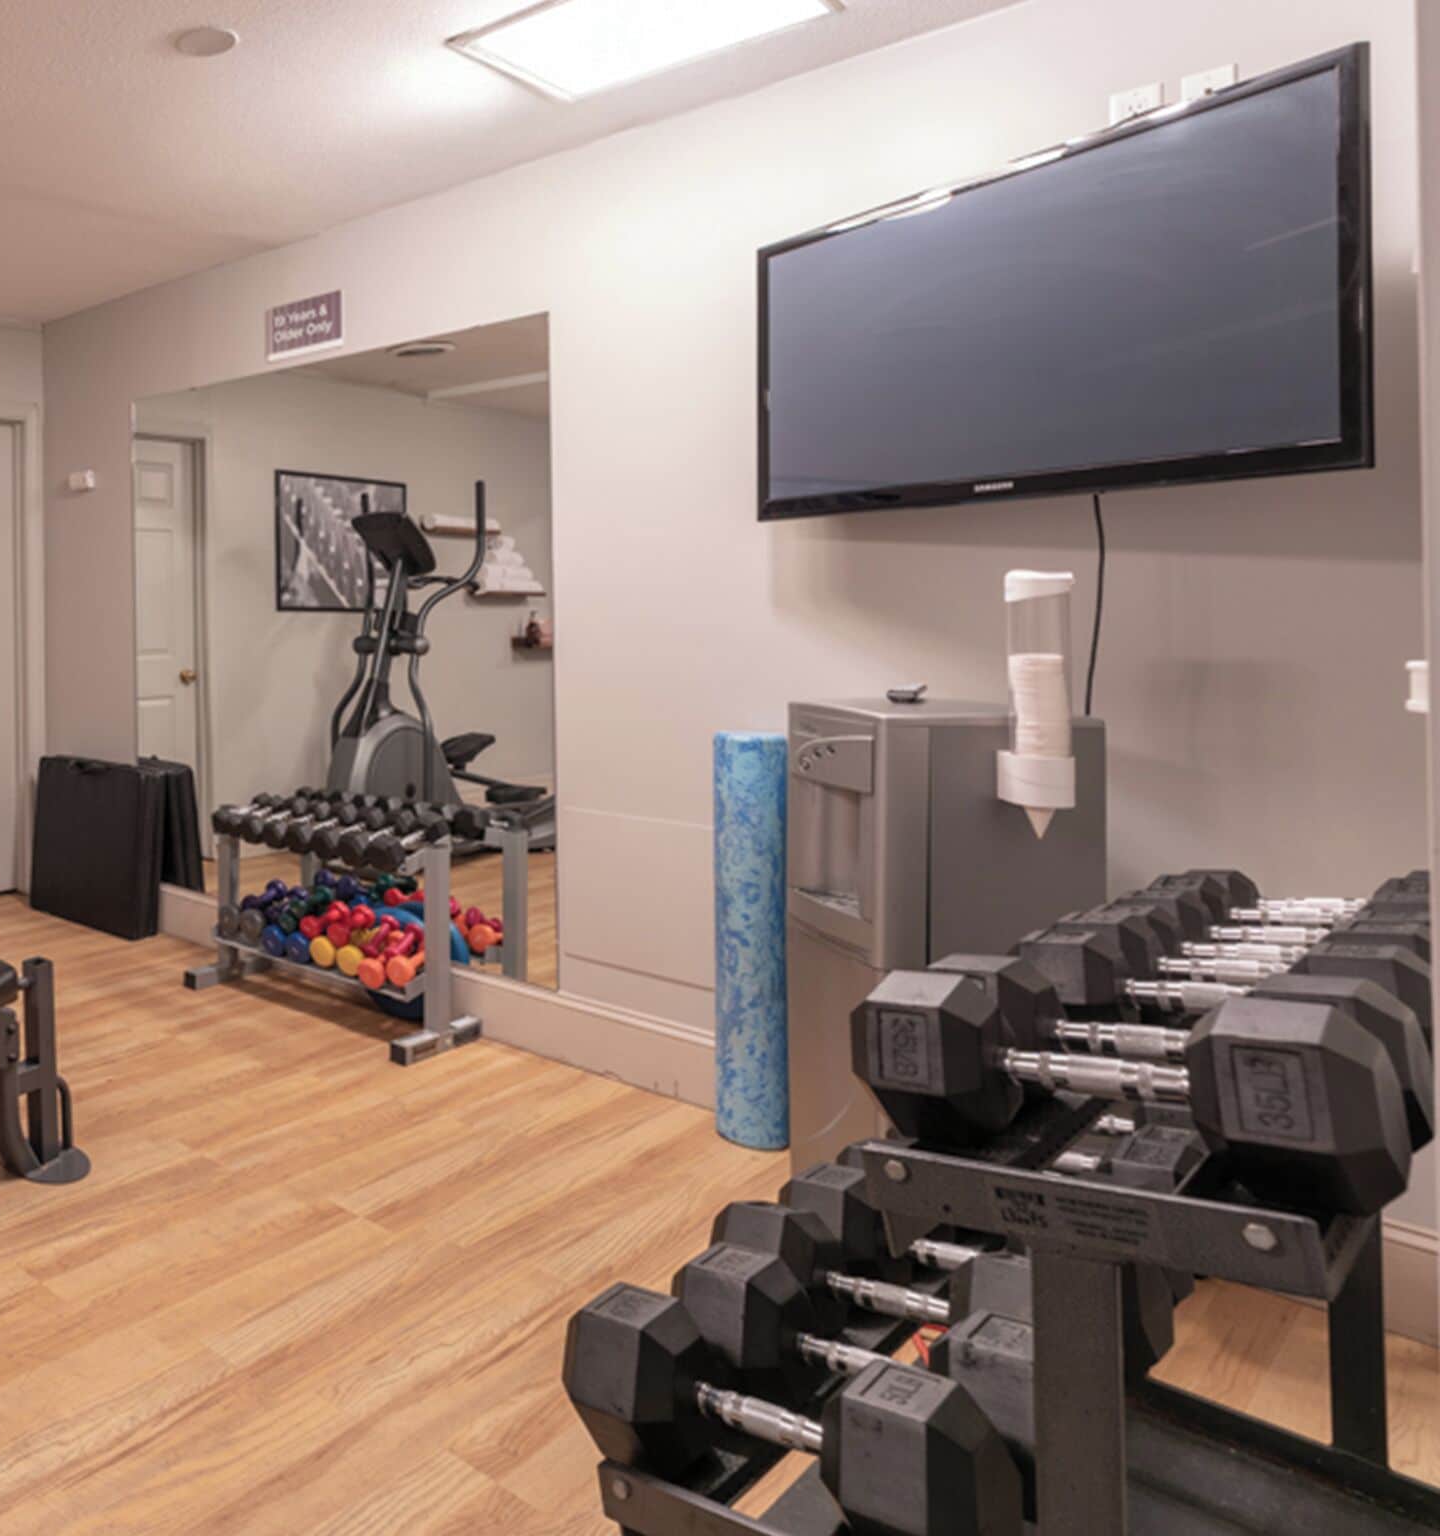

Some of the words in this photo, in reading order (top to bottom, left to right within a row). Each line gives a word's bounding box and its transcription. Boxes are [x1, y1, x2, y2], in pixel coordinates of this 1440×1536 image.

[288, 309, 317, 322] Years
[274, 327, 303, 343] Older
[306, 320, 333, 335] Only
[974, 481, 1014, 493] SAMSUNG
[1245, 1056, 1296, 1130] 35LB
